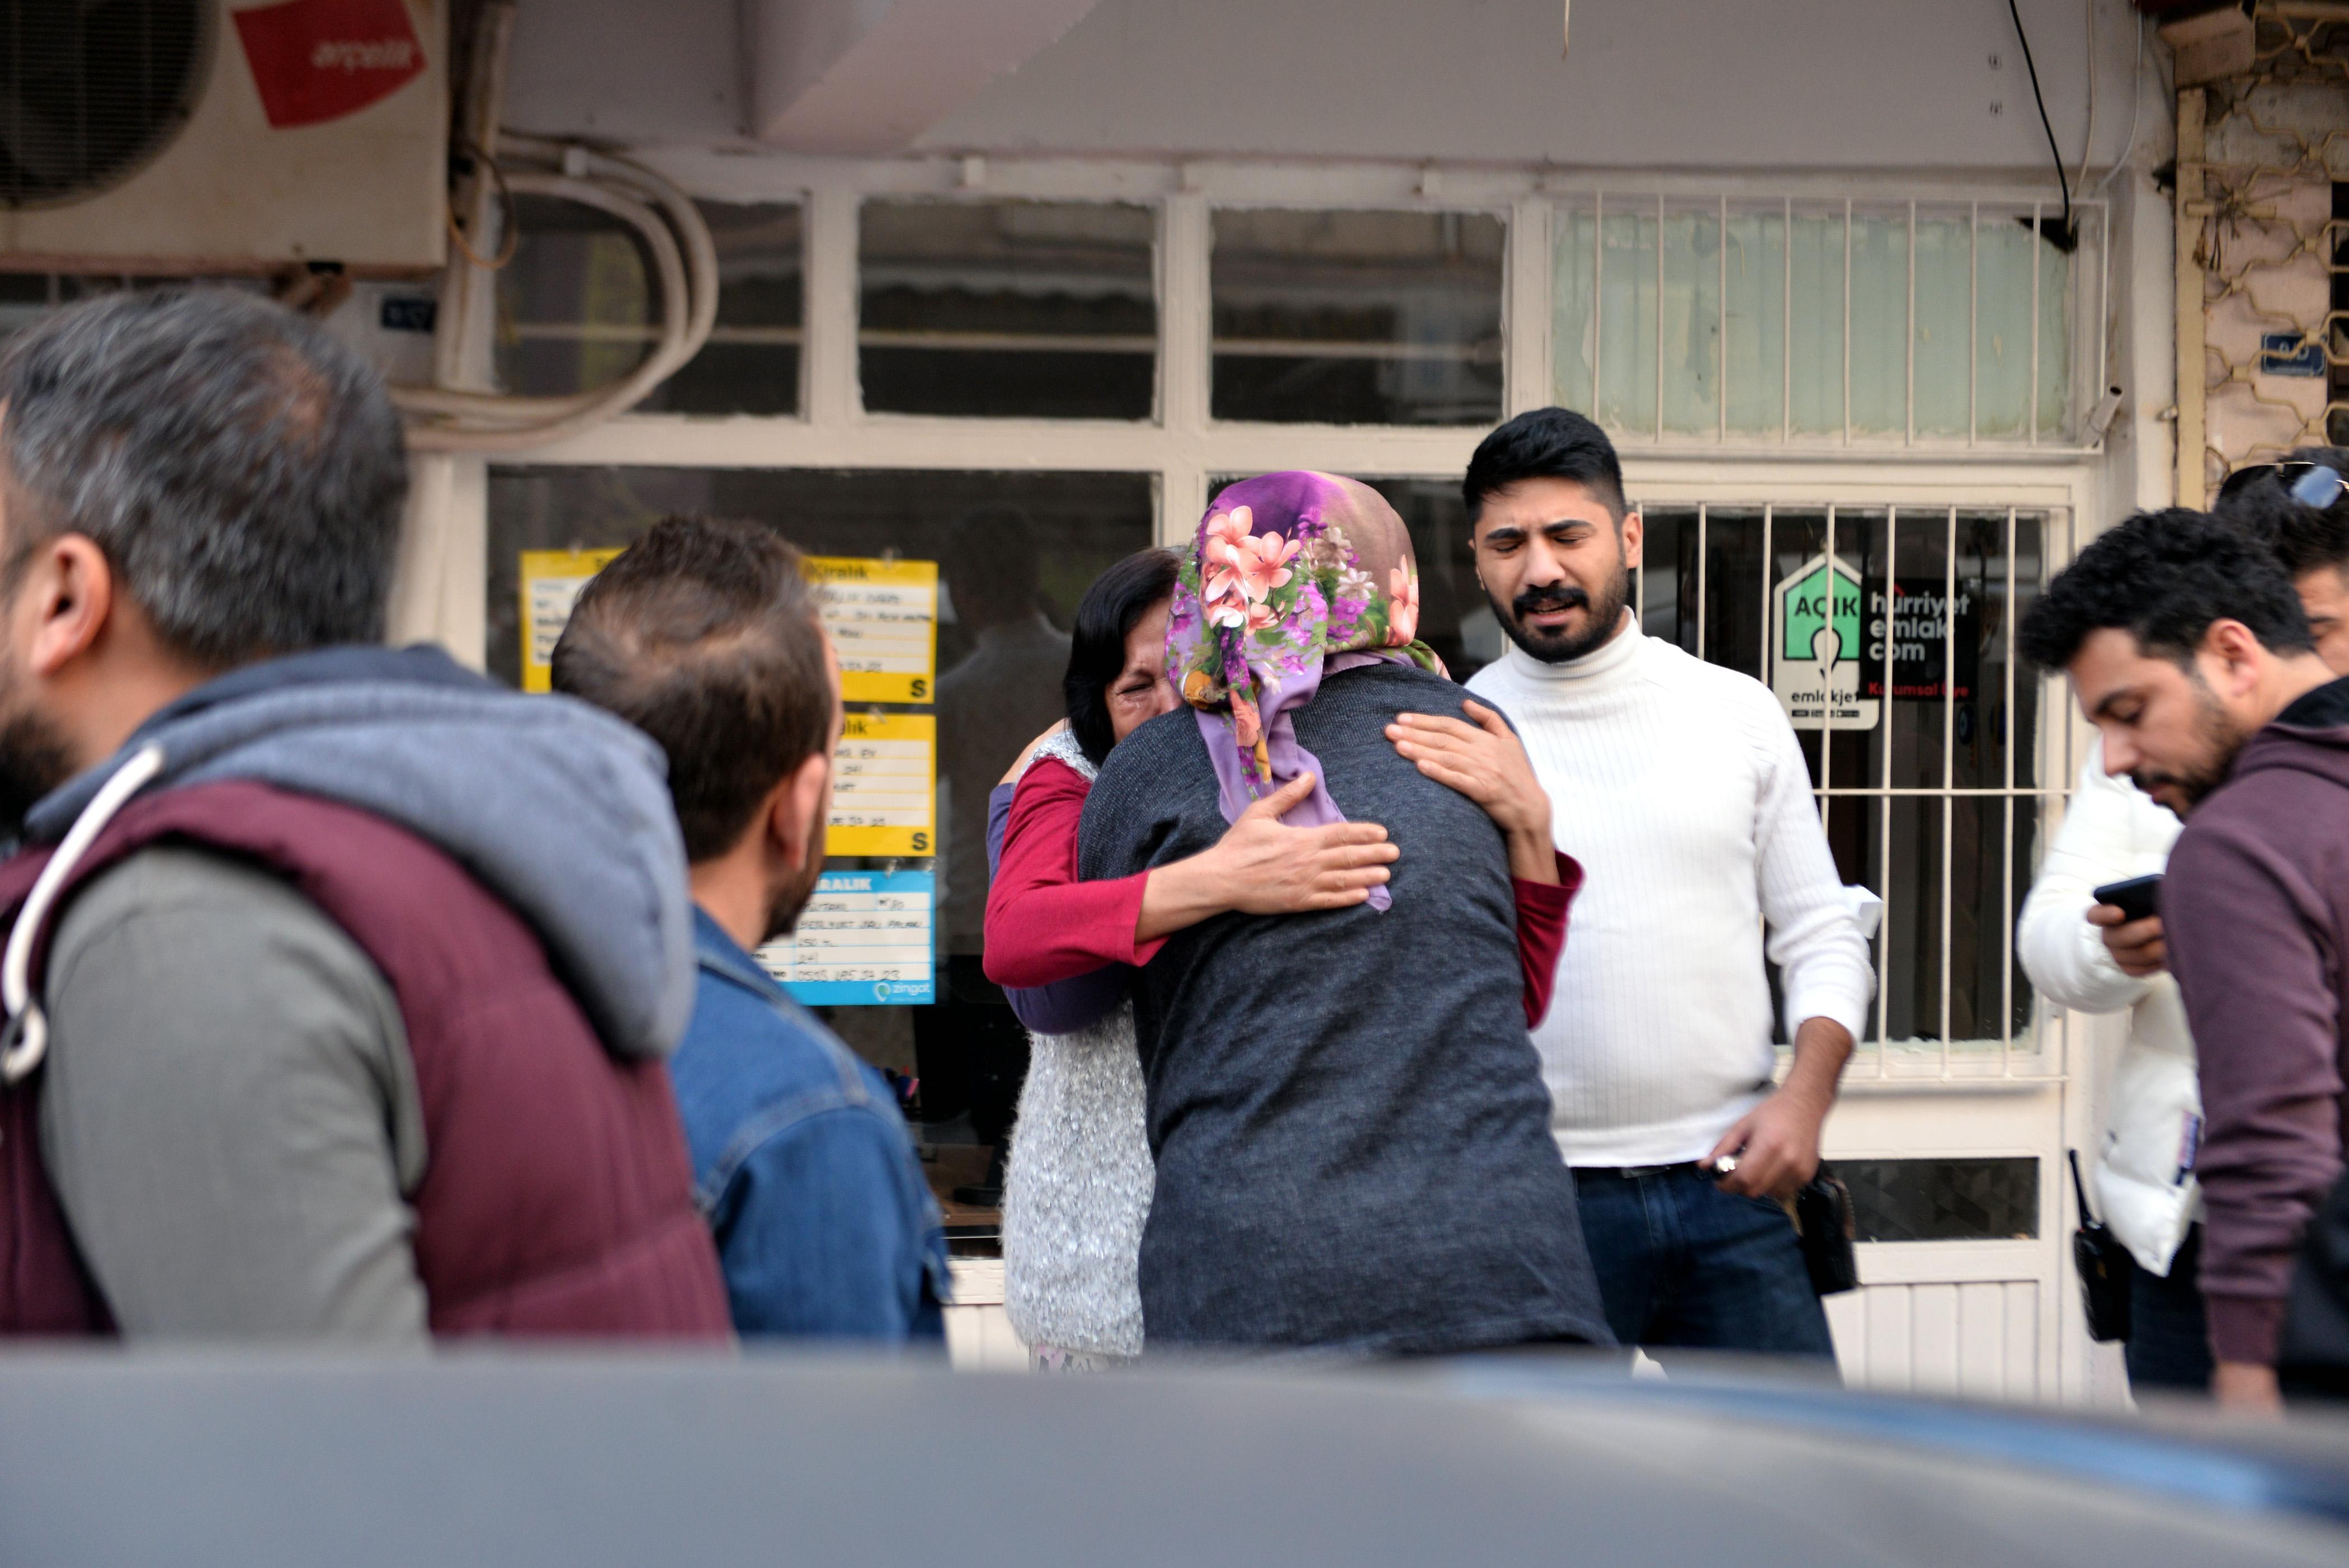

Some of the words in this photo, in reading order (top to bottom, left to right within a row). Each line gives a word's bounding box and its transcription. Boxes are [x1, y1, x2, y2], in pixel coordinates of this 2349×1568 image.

[1794, 596, 1857, 619] AÇIK
[1870, 616, 1955, 639] emlak
[1869, 641, 1926, 662] com
[911, 679, 927, 697] S
[1869, 681, 1937, 696] Kuumsal
[912, 832, 928, 851] S
[893, 982, 931, 995] zingat
